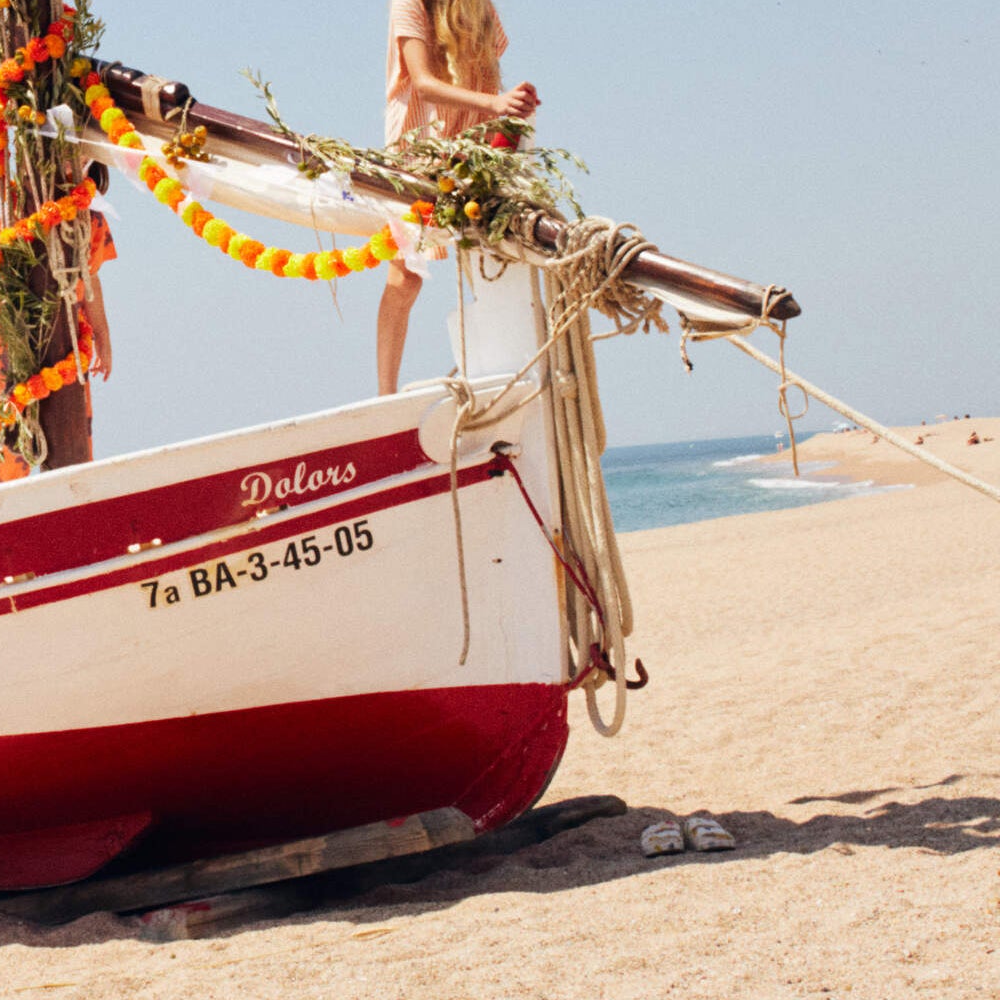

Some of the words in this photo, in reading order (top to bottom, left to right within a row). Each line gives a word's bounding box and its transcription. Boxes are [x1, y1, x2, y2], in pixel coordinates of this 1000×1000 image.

[240, 461, 357, 507] Dolors
[141, 581, 181, 608] 7a
[189, 520, 374, 598] BA-3-45-05
